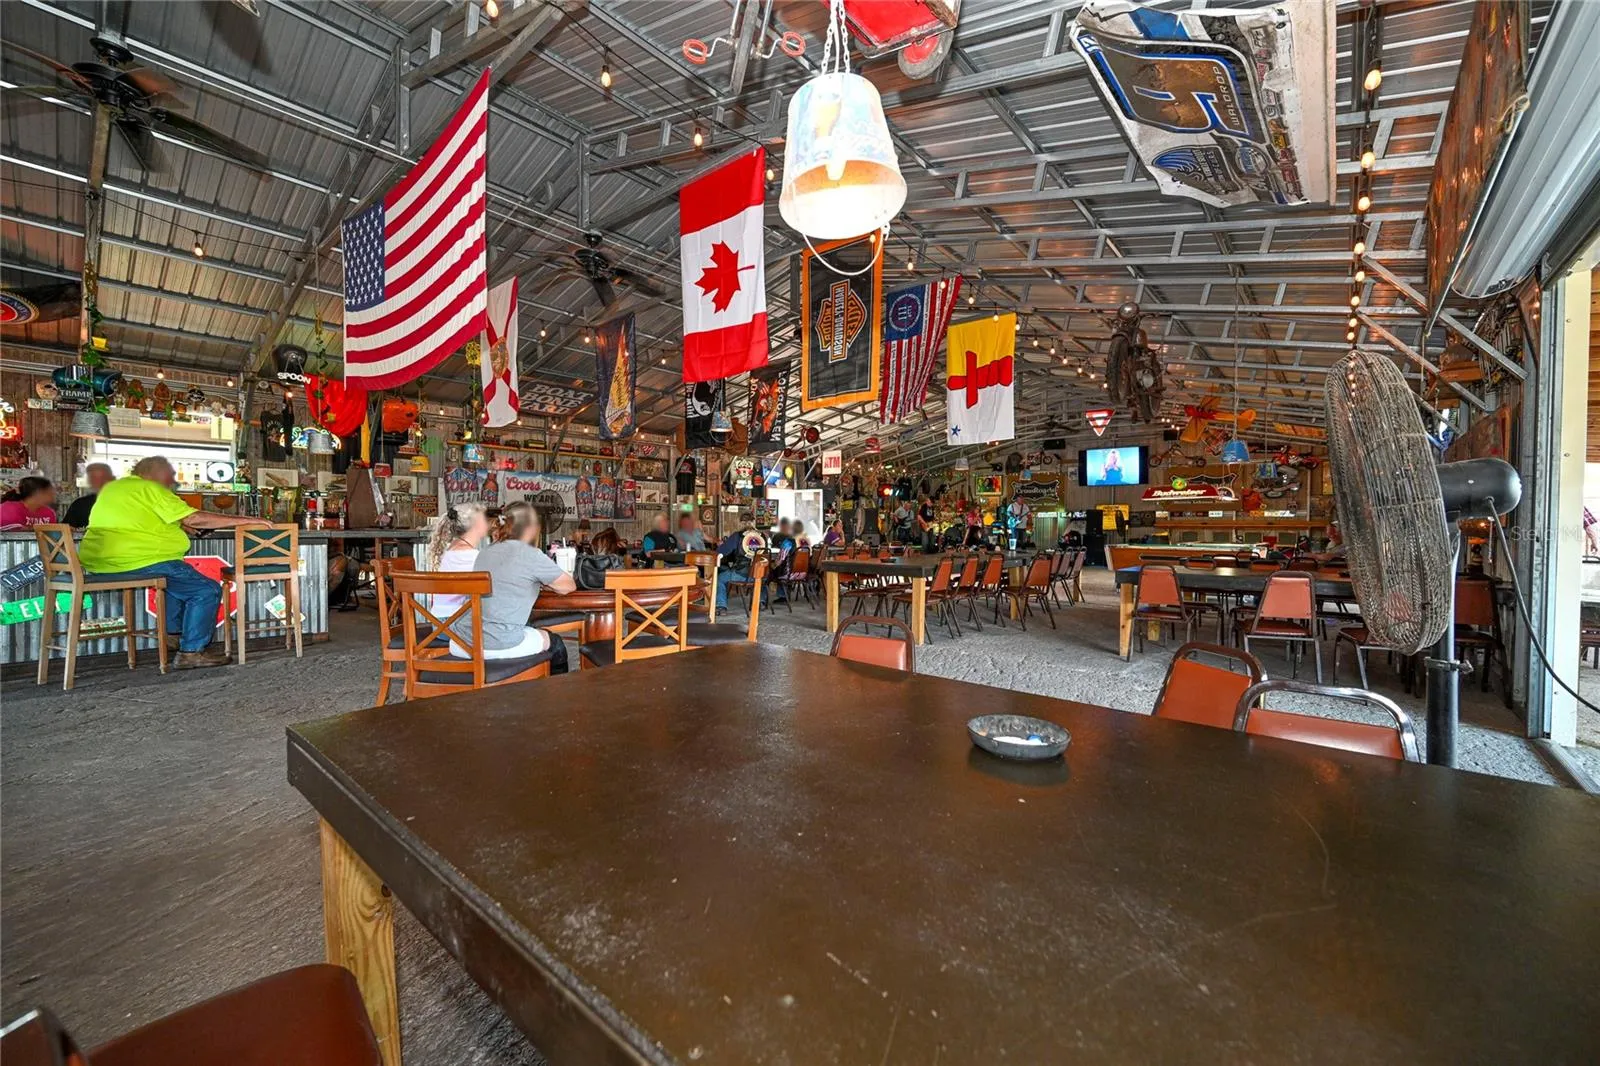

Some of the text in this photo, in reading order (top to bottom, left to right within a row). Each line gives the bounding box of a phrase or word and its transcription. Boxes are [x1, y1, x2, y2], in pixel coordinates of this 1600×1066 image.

[1213, 66, 1241, 126] WALDROP
[277, 372, 312, 384] SPOON
[529, 384, 594, 400] BOAT
[520, 392, 581, 408] BONE
[824, 456, 840, 468] ATM
[505, 476, 572, 493] Coors LIGHT
[524, 494, 555, 502] WE ARE
[1152, 489, 1206, 497] Budweiser
[550, 506, 575, 514] RONG!
[2, 570, 27, 586] 117
